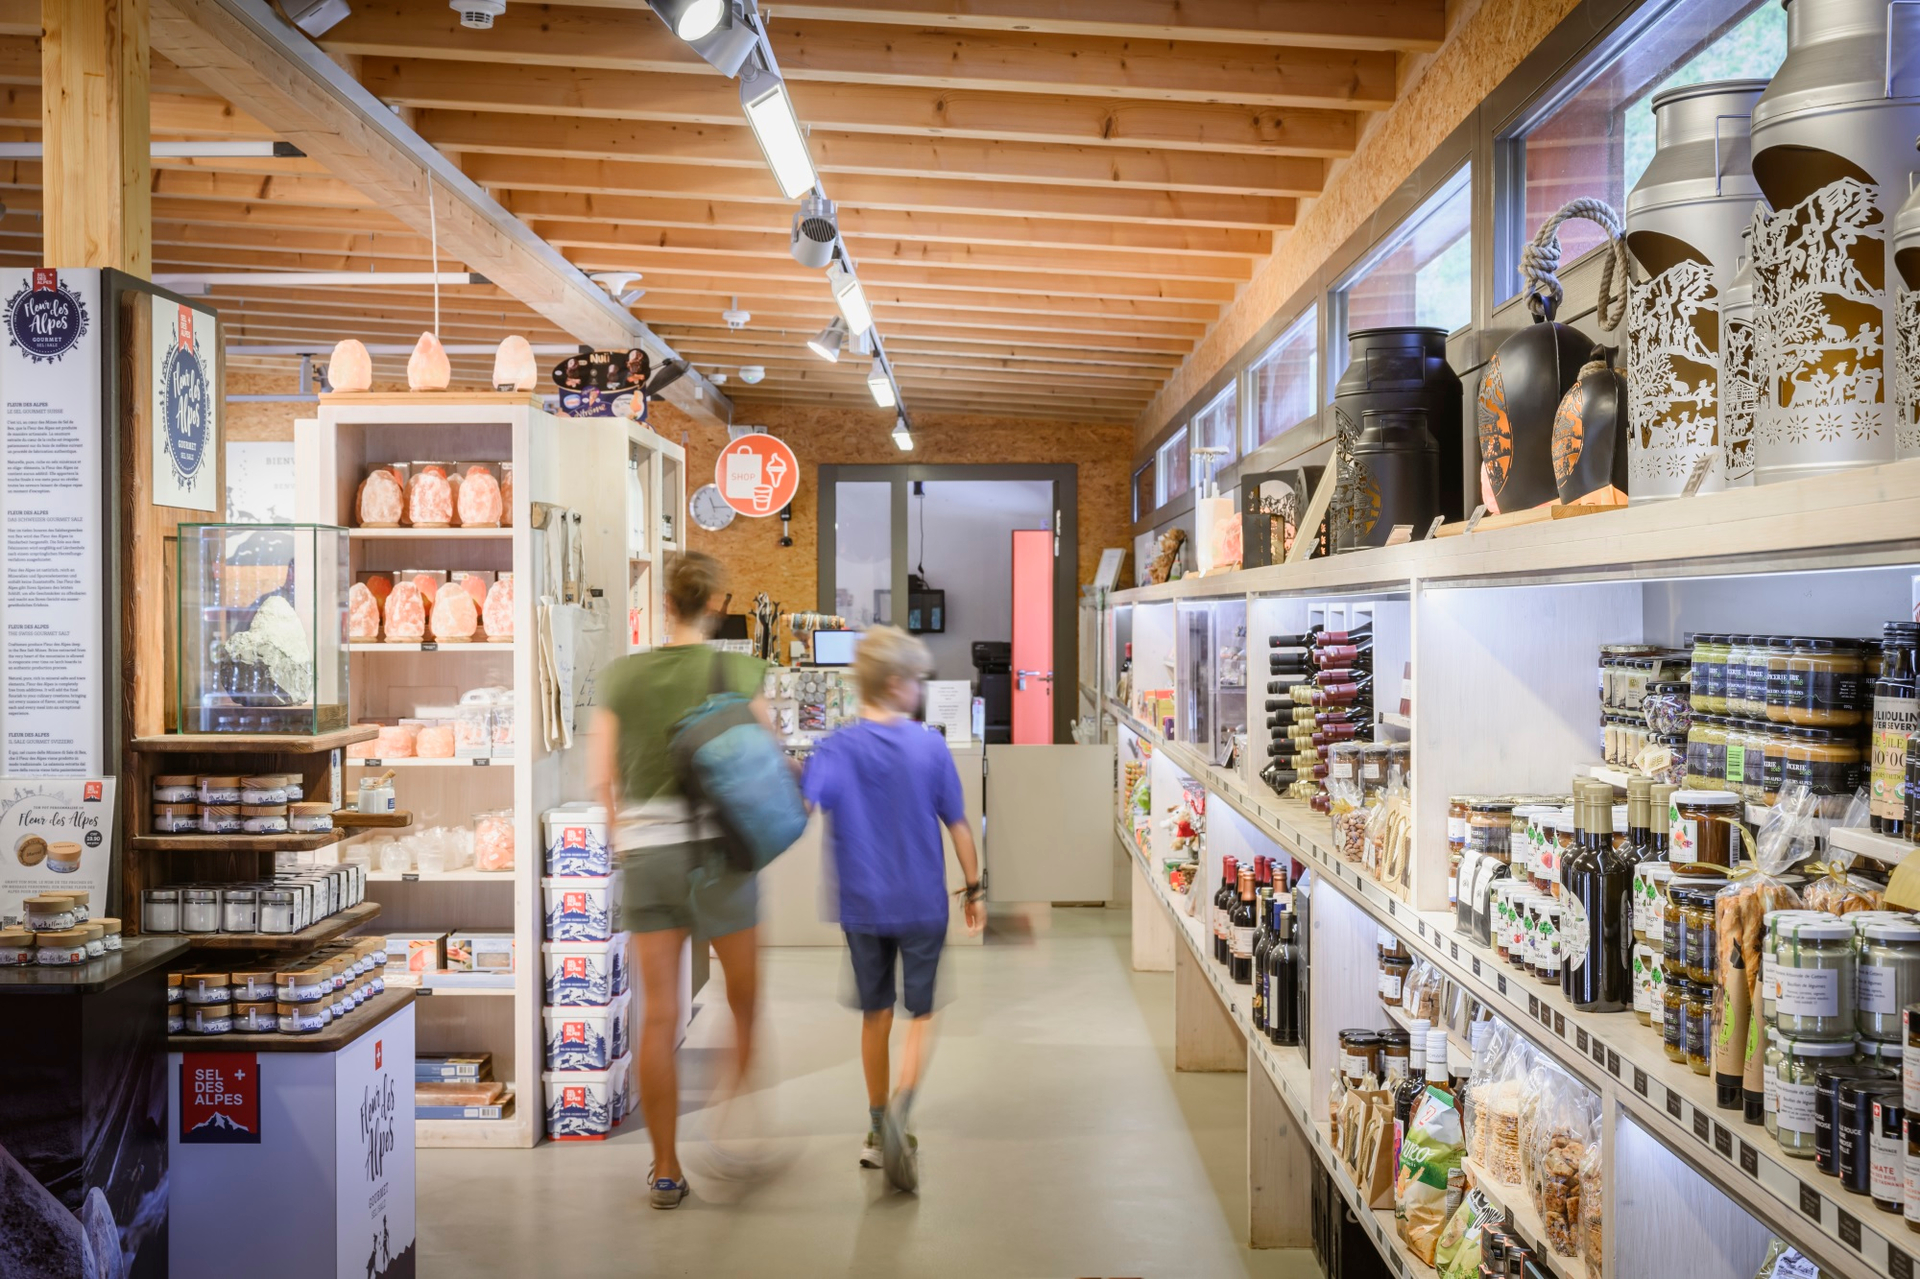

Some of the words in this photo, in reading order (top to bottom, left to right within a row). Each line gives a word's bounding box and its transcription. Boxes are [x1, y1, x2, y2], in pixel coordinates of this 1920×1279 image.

[24, 297, 51, 317] Fleur
[50, 299, 69, 317] des
[29, 313, 68, 336] Alpes
[173, 361, 190, 398] Fleur
[176, 393, 201, 437] Alpes
[731, 473, 756, 481] SHOP
[19, 810, 48, 827] Fleur
[50, 812, 66, 827] des
[69, 811, 99, 830] Alpes
[195, 1069, 223, 1080] SEL
[195, 1081, 224, 1093] DES
[195, 1094, 244, 1106] ALPES
[360, 1085, 380, 1144] Fleur
[1843, 1126, 1862, 1136] ROUGE
[365, 1116, 394, 1182] Alpes
